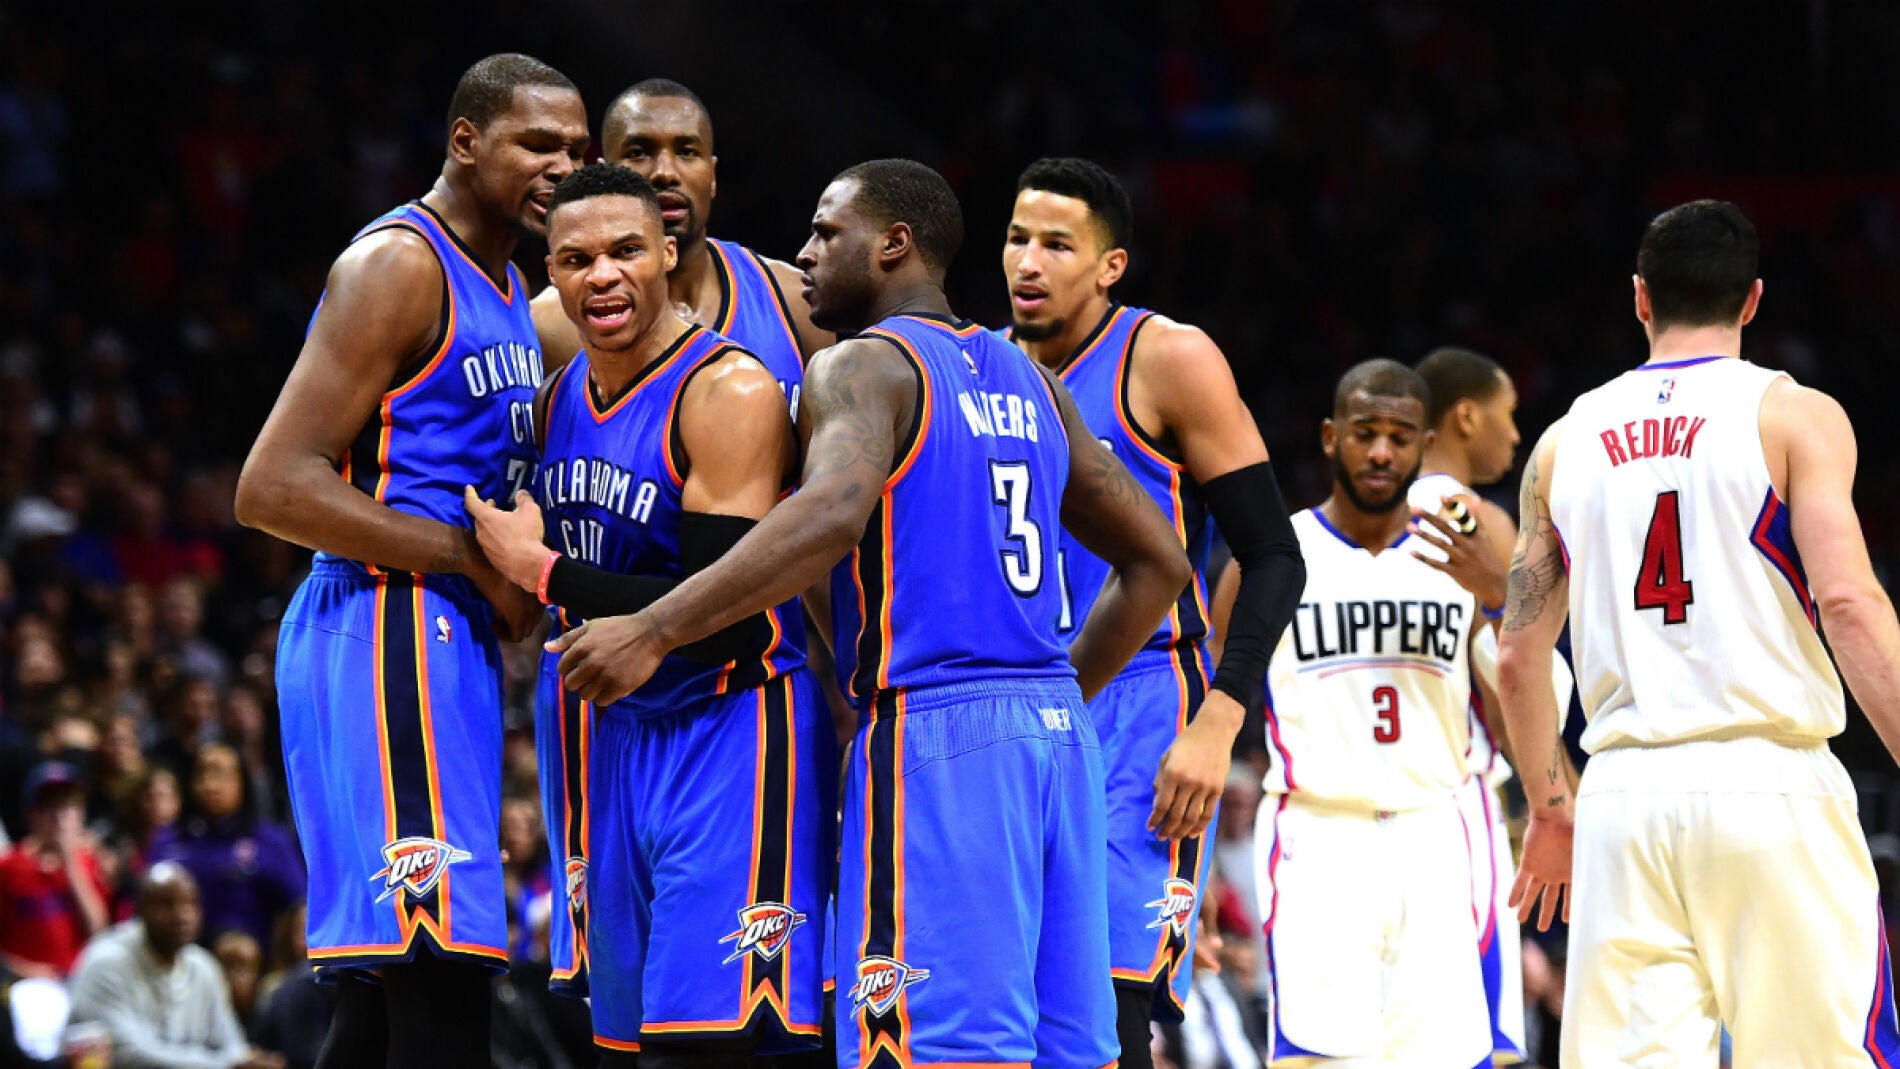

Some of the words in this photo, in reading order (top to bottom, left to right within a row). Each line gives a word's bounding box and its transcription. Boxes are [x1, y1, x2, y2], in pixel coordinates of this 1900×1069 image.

[1600, 415, 1706, 467] REDICK
[561, 519, 604, 566] CITY
[989, 459, 1044, 597] 3
[1634, 490, 1694, 625] 4
[1293, 600, 1463, 662] CLIPPERS
[1372, 686, 1400, 743] 3
[388, 849, 437, 886] OKC
[740, 913, 785, 947] OKC
[1161, 895, 1193, 918] OKC
[856, 969, 894, 1003] OKC
